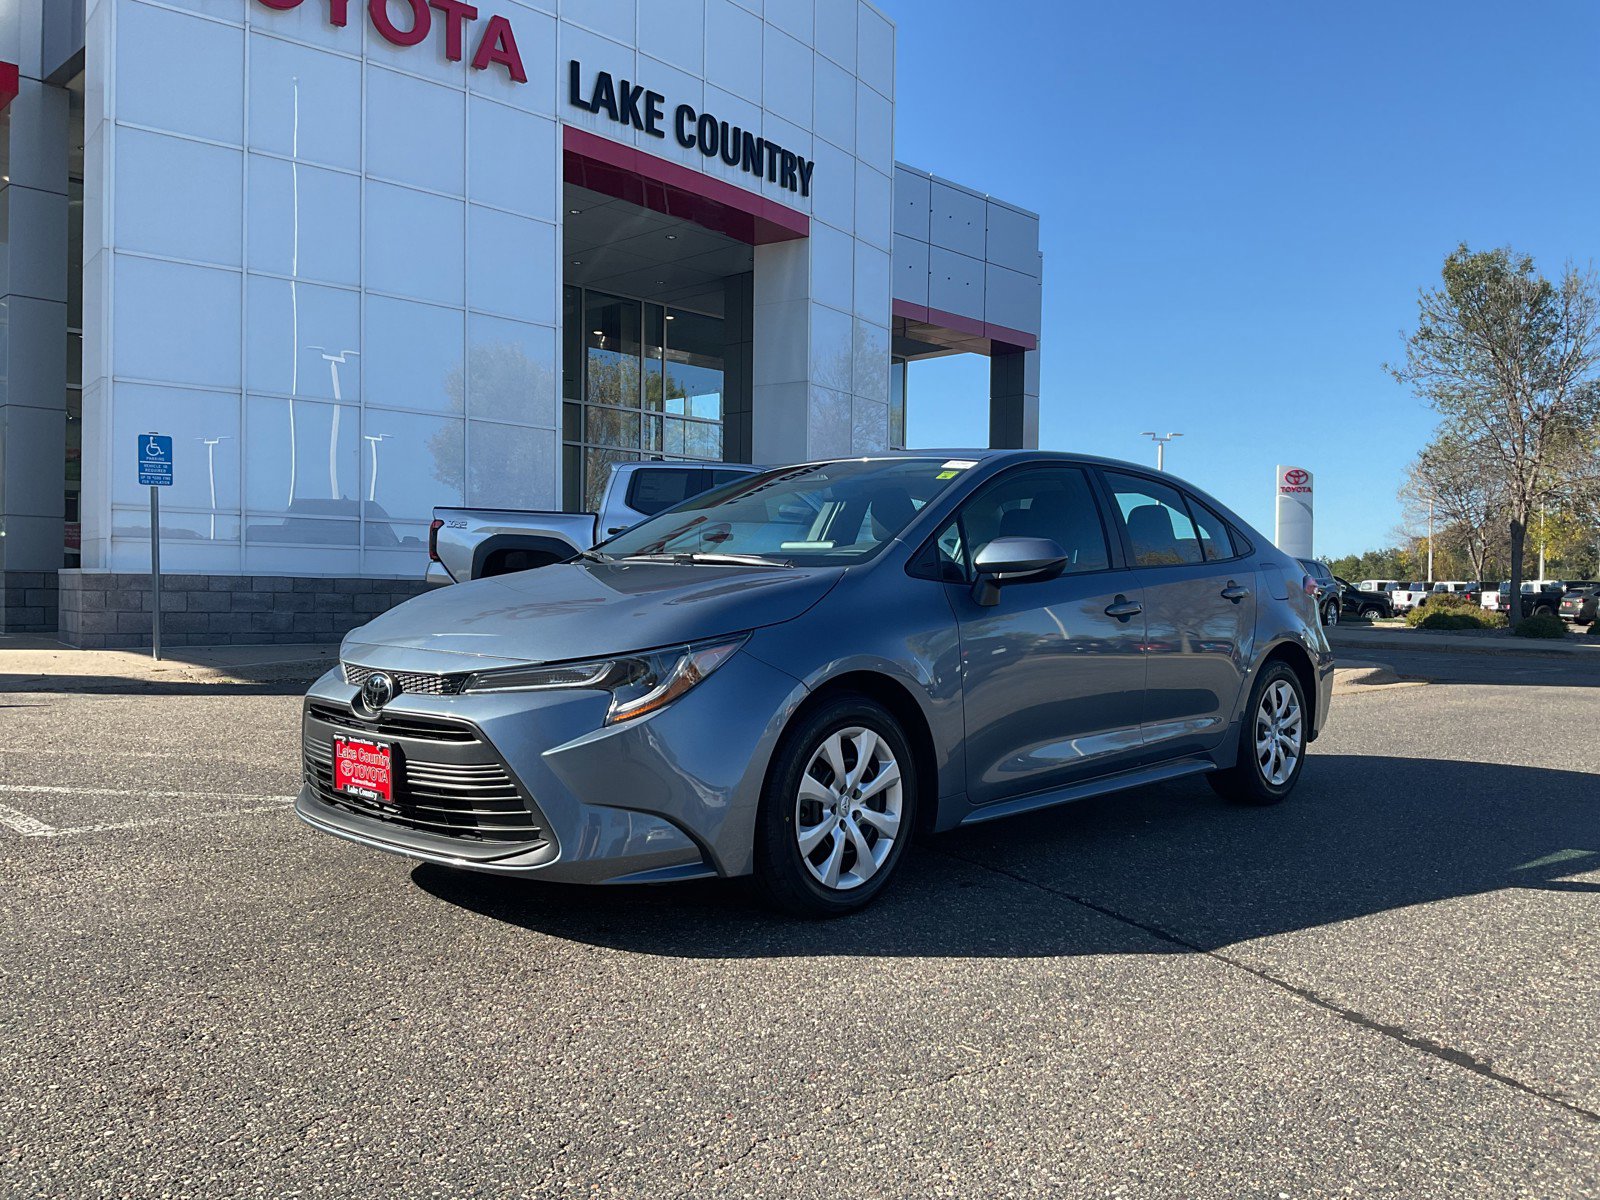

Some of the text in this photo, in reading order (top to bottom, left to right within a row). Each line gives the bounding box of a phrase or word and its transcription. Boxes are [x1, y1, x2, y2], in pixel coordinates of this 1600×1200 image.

[569, 59, 815, 197] LAKE COUNTRY
[336, 744, 390, 770] Lake Country
[353, 763, 388, 784] TOYOTA
[347, 785, 378, 800] Lake Country
